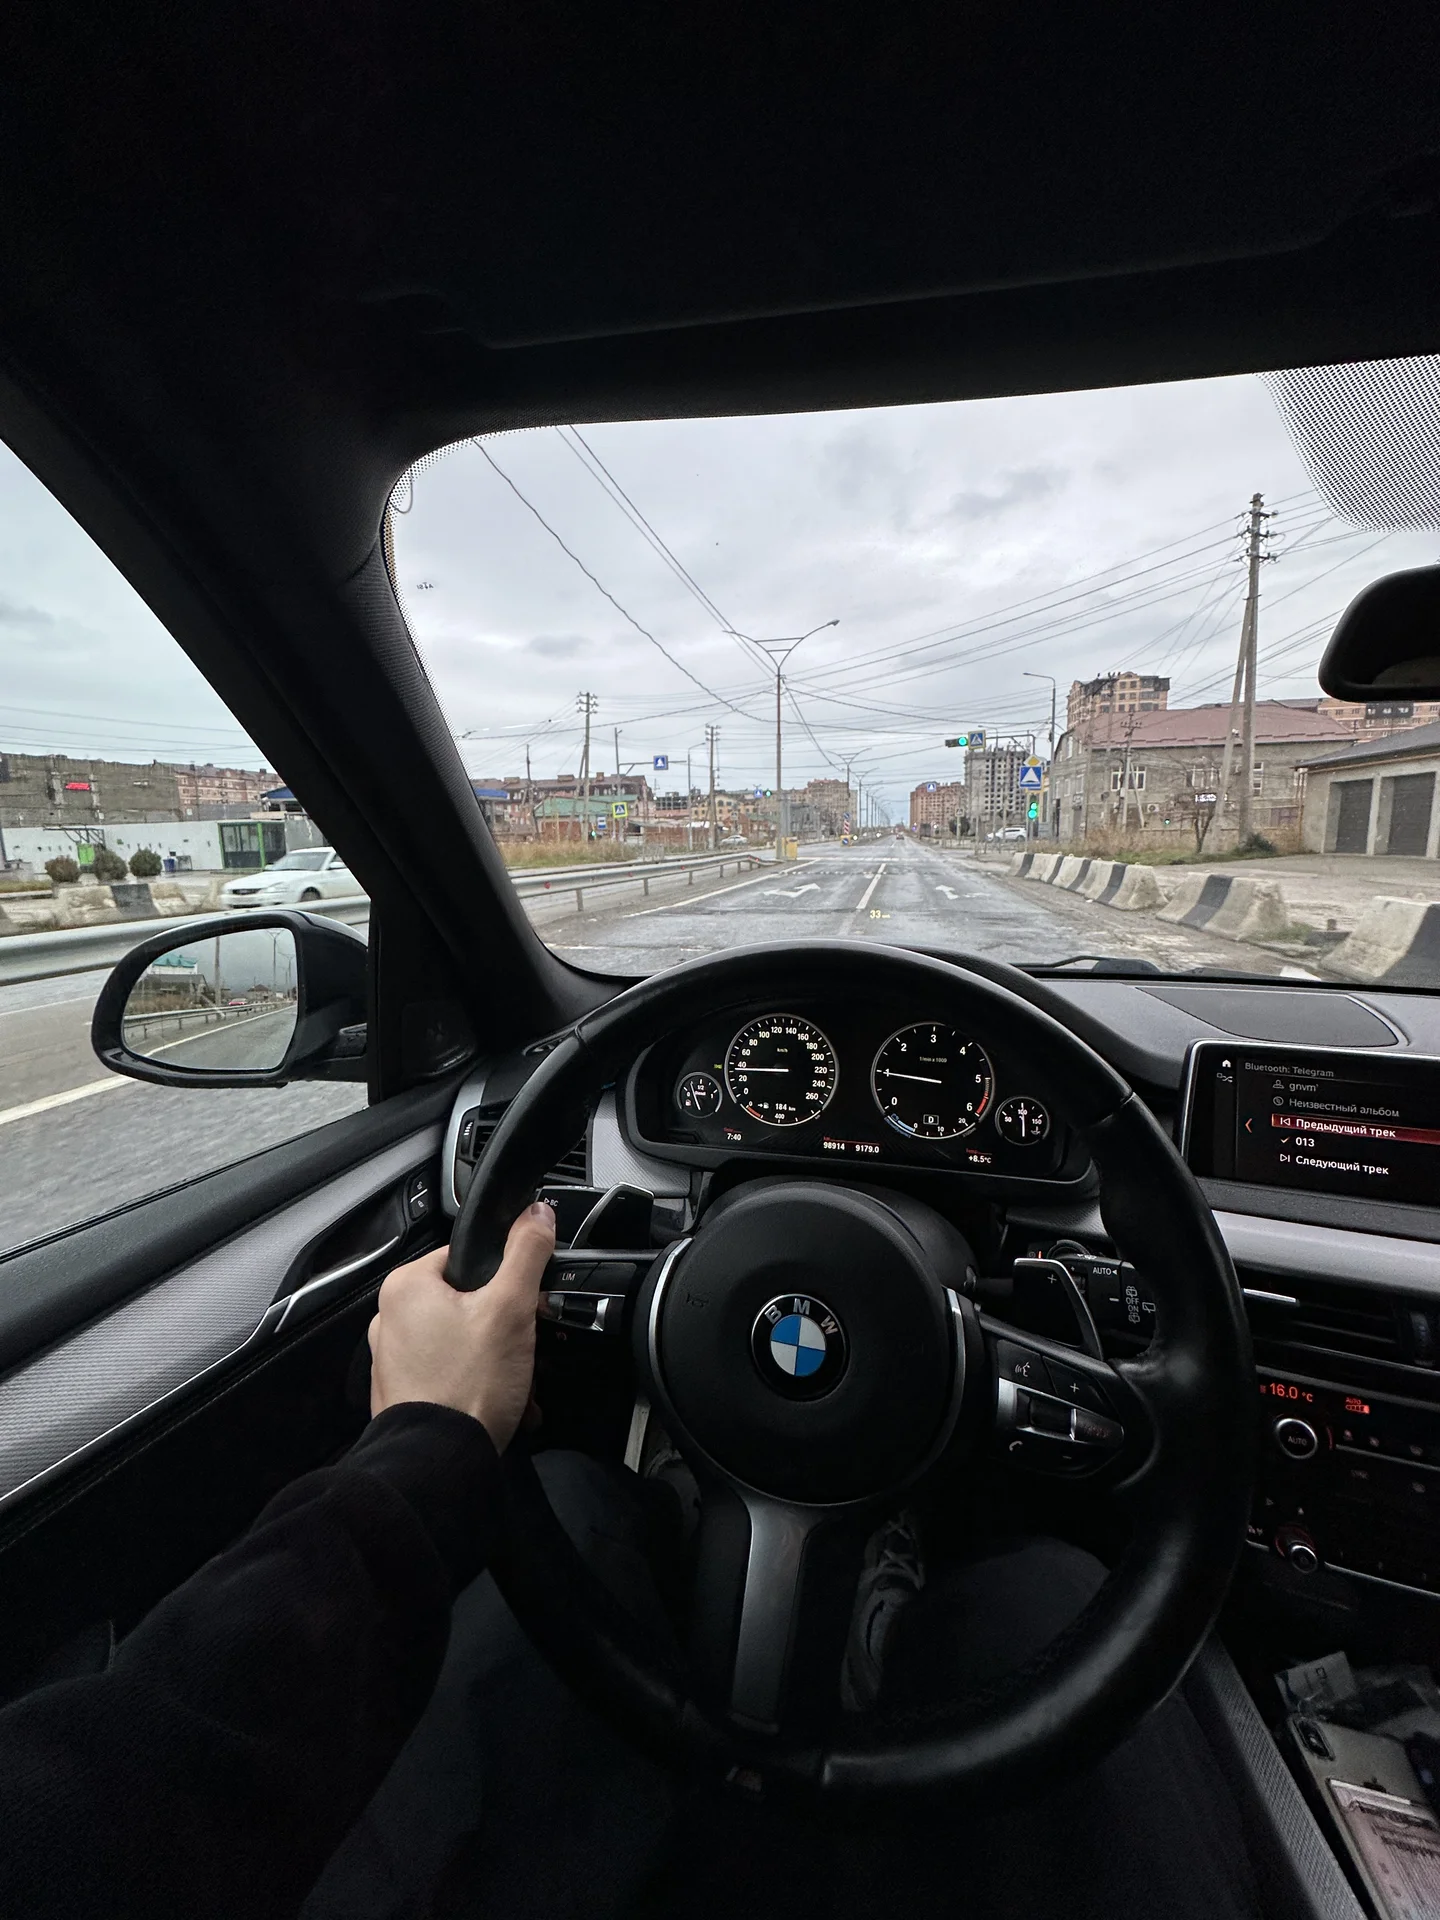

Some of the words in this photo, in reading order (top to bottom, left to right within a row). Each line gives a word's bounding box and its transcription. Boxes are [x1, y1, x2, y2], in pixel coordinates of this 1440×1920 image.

[870, 910, 881, 918] 33
[930, 1034, 936, 1043] 3
[901, 1043, 907, 1051] 2
[960, 1046, 966, 1055] 4
[1244, 1062, 1290, 1074] Bluetooth:
[1293, 1066, 1334, 1077] Telegram
[975, 1074, 981, 1083] 5
[891, 1097, 898, 1105] 0
[966, 1102, 973, 1111] 6
[1289, 1099, 1357, 1113] Неизвестный
[1360, 1105, 1400, 1117] альбом
[1296, 1118, 1367, 1135] Предыдущий
[1369, 1128, 1396, 1138] трек
[1295, 1137, 1315, 1147] 013
[823, 1142, 845, 1150] 98914
[855, 1144, 880, 1153] 9179.0
[1296, 1156, 1360, 1172] Следующий
[1362, 1164, 1389, 1175] трек
[1093, 1267, 1111, 1276] AUTO
[764, 1298, 838, 1335] BMW
[1270, 1383, 1298, 1399] 16.0
[1346, 1397, 1361, 1405] AUTO
[1288, 1436, 1307, 1446] AUTO
